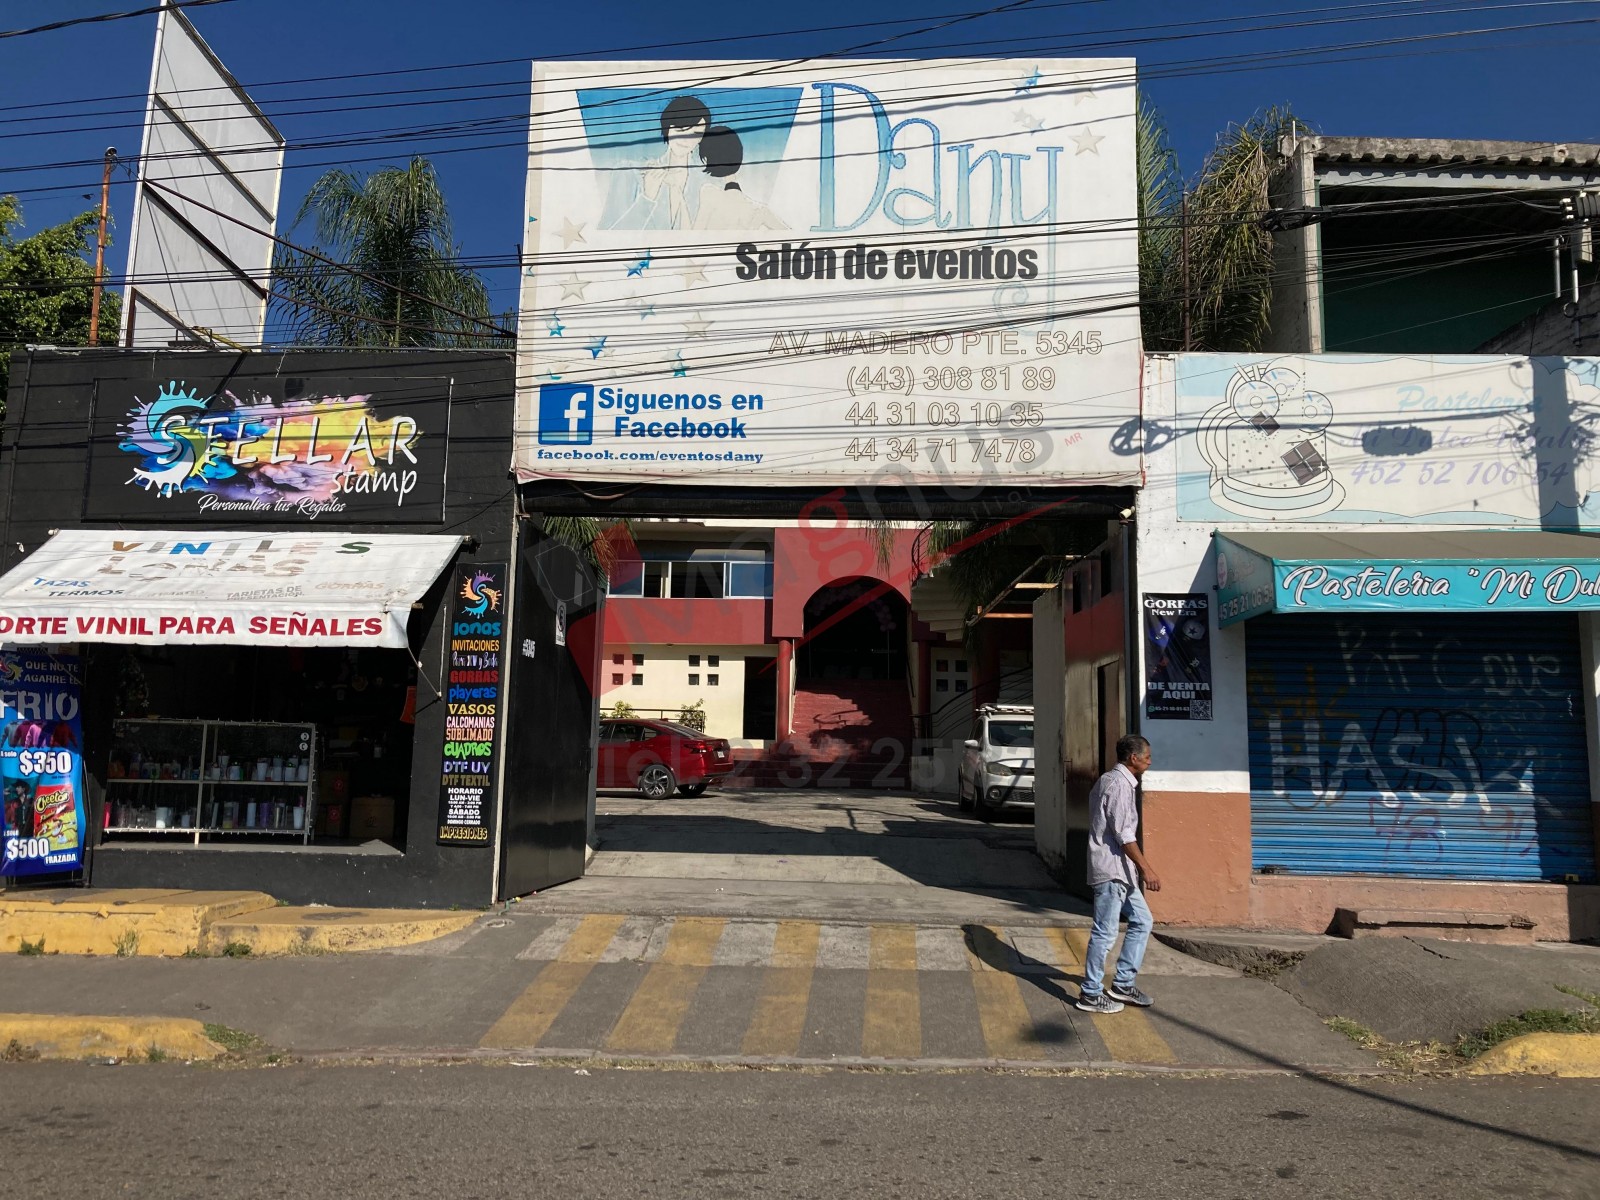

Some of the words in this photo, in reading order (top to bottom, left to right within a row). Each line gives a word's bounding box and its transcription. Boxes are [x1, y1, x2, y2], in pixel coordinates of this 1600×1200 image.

[809, 82, 1064, 336] Dany
[736, 242, 836, 280] Salón
[843, 243, 888, 280] de
[894, 245, 1039, 280] eventos
[769, 331, 816, 355] AV.
[825, 331, 954, 355] MADERO
[962, 331, 1028, 355] PTE.
[1035, 331, 1103, 355] 5345
[846, 366, 916, 396] (443)
[923, 366, 973, 391] 308
[981, 366, 1011, 391] 81
[1022, 366, 1056, 391] 89
[598, 388, 722, 414] Siguenos
[731, 393, 764, 410] en
[845, 402, 879, 426] 44
[886, 402, 917, 426] 31
[927, 402, 960, 426] 03
[970, 402, 1002, 426] 10
[1009, 402, 1044, 426] 35
[615, 416, 747, 439] Facebook
[157, 415, 418, 465] STELLAR
[537, 449, 764, 463] facebook.com/eventosdany
[844, 438, 879, 462] 44
[886, 438, 919, 462] 34
[928, 438, 958, 462] 71
[968, 438, 1037, 463] 7478
[1350, 460, 1407, 485] 452
[1418, 460, 1456, 485] 52
[1466, 460, 1518, 485] 106
[1531, 461, 1569, 486] 54
[331, 465, 418, 506] stamp
[197, 494, 272, 515] Personaliza
[273, 495, 292, 512] tus
[294, 495, 347, 520] Regalos
[33, 577, 92, 588] TAZAS
[48, 589, 125, 597] TERMOS
[1144, 600, 1208, 608] GORRAS
[76, 616, 154, 636] VINIL
[159, 616, 236, 635] PARA
[249, 611, 383, 636] SEÑALES
[452, 640, 500, 651] INVITACIONES
[25, 661, 48, 671] QUE
[67, 663, 79, 672] TE
[24, 673, 67, 684] AGARRE
[450, 670, 499, 683] GORRAS
[449, 684, 497, 703] playeras
[1148, 682, 1165, 690] DE
[1168, 682, 1210, 691] VENTA
[1162, 691, 1196, 700] AQUI
[0, 690, 79, 721] FRIO
[448, 704, 496, 715] VASOS
[446, 716, 495, 728] CALCOMANIAS
[446, 728, 493, 741] SUBLIMADO
[444, 741, 492, 760] CUADROS
[20, 750, 71, 776] $350
[443, 761, 468, 773] DTF
[471, 761, 491, 773] UV
[442, 774, 459, 786] DTF
[461, 774, 490, 787] TEXTIL
[440, 826, 488, 840] IMPRESIONES
[7, 838, 50, 860] $500
[45, 853, 77, 865] FRAZADA
